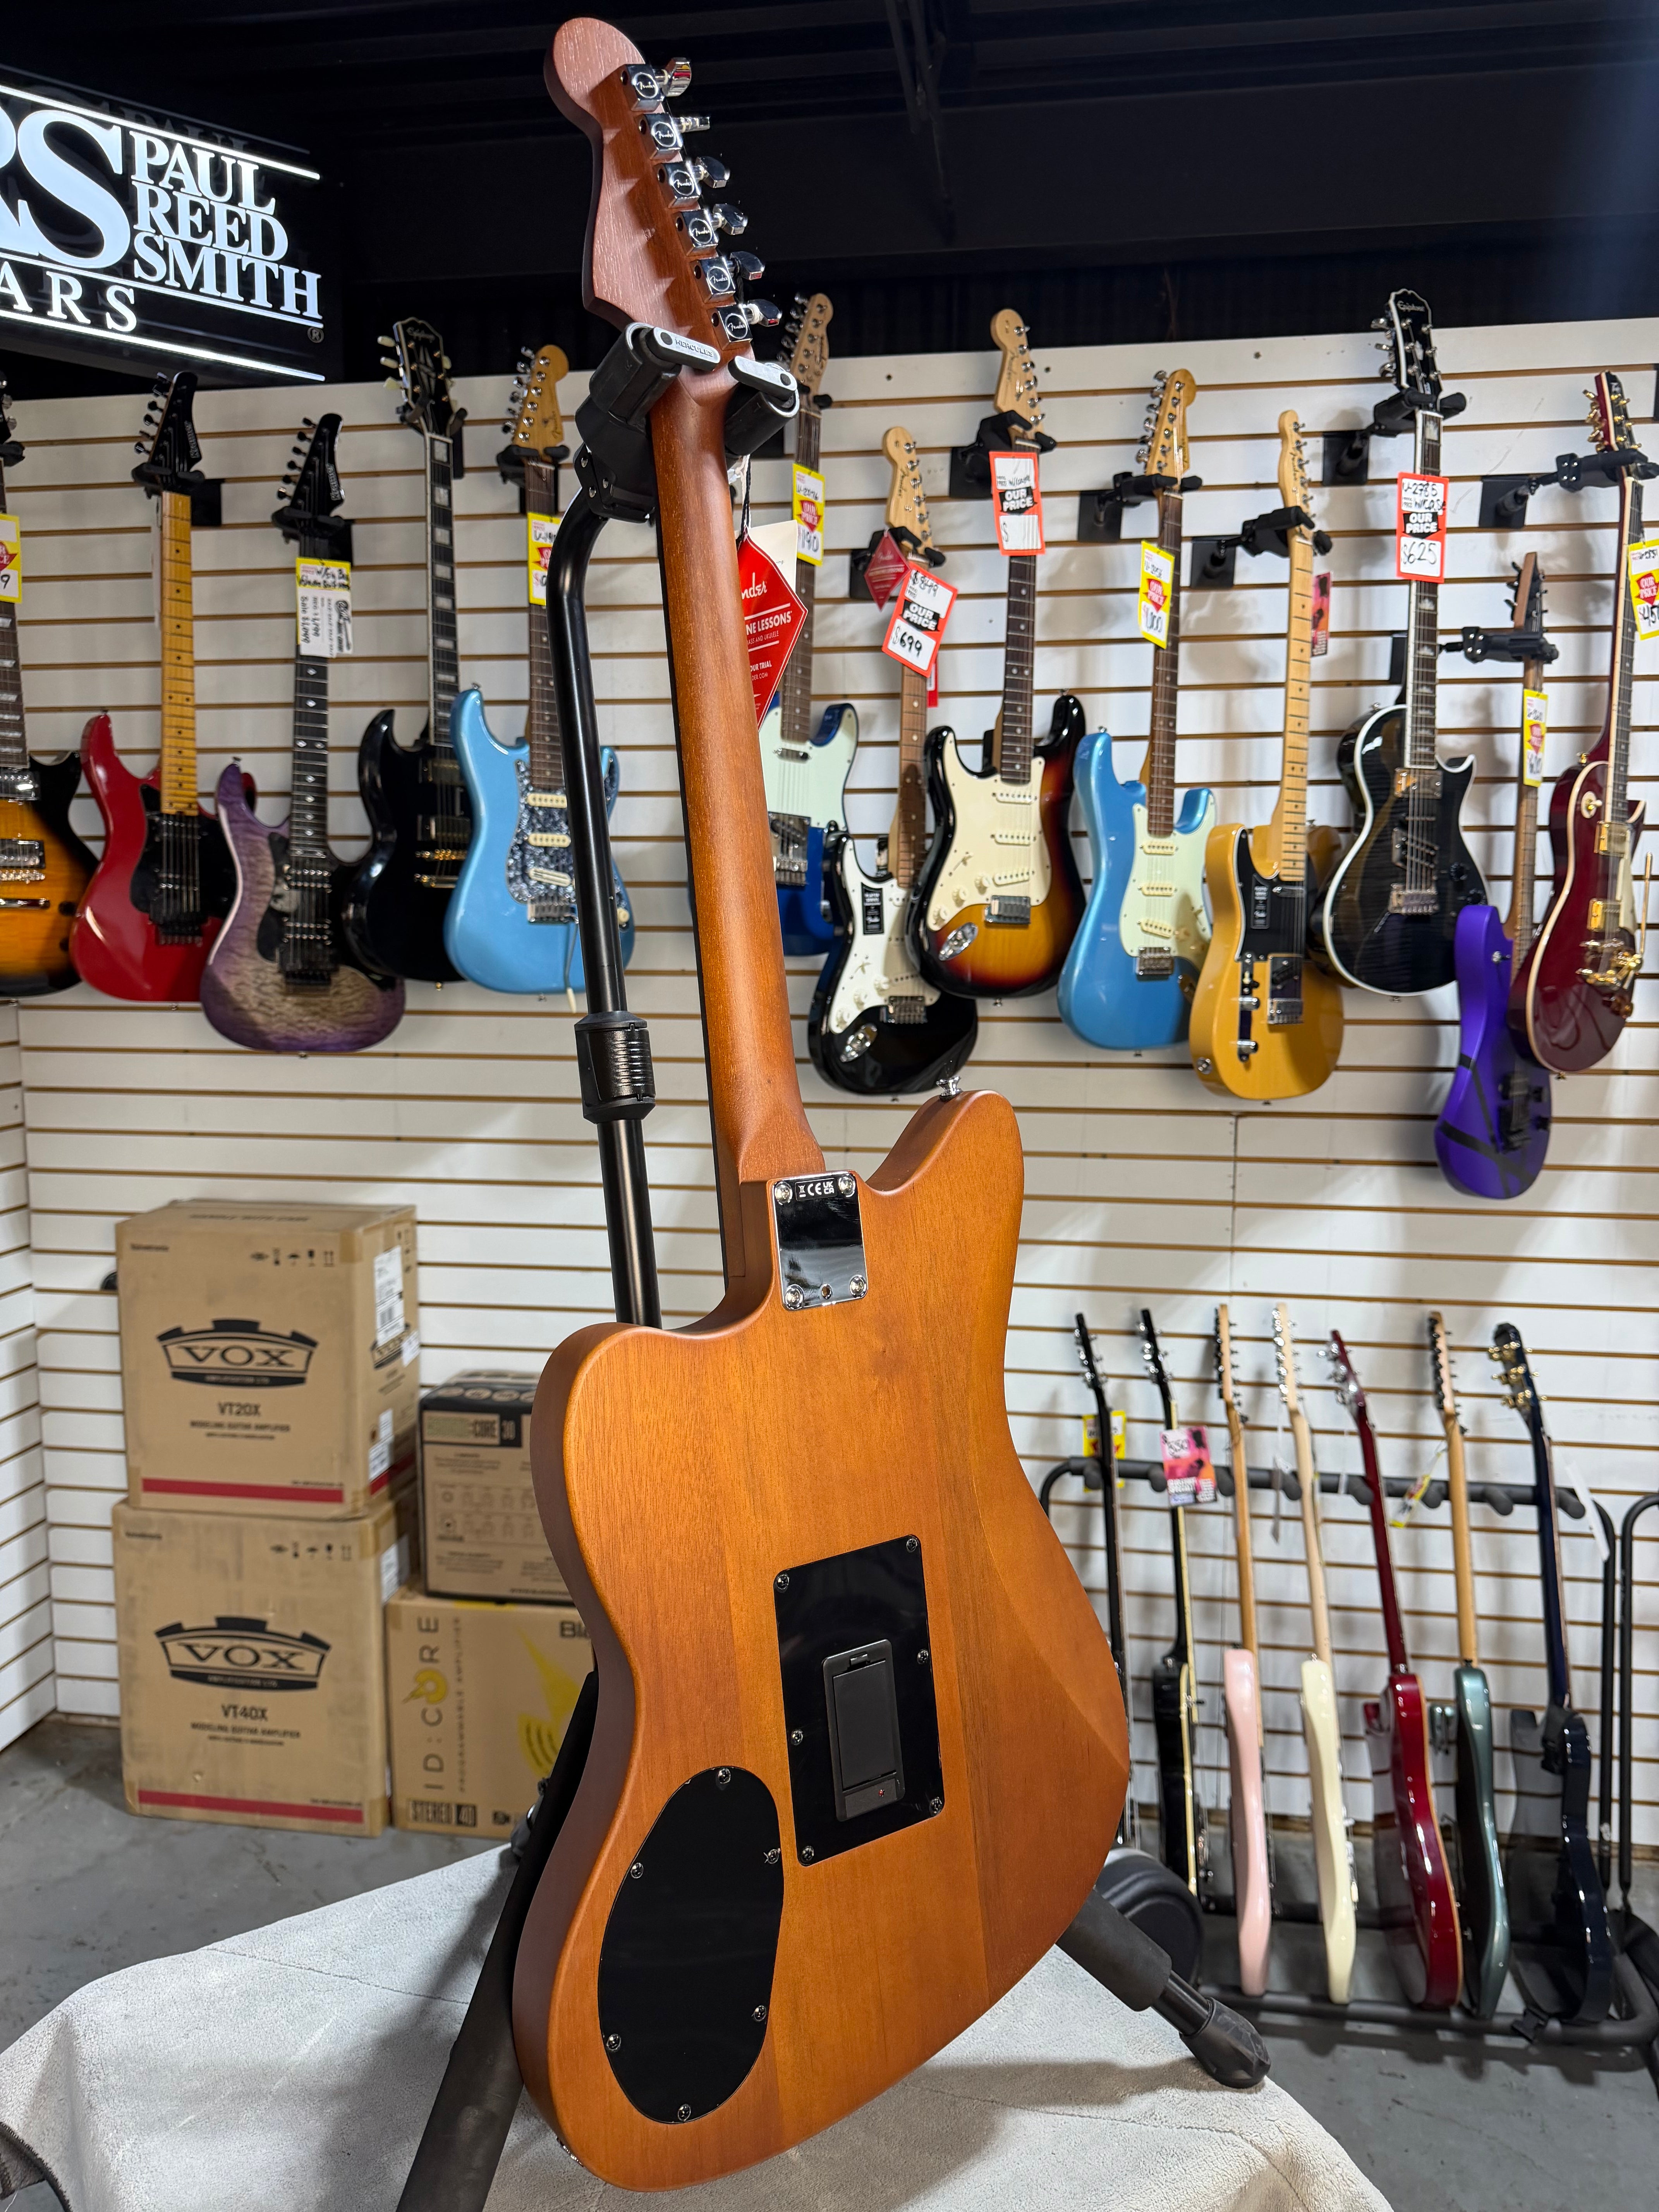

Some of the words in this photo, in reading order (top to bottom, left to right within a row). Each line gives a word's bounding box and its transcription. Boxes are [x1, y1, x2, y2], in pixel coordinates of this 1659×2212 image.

[655, 130, 674, 139] Fender
[129, 130, 275, 215] PAUL
[673, 179, 692, 188] Fender
[132, 180, 288, 262] REED
[692, 227, 710, 236] Fender
[133, 232, 322, 319] SMITH
[710, 275, 728, 283] Fender
[727, 322, 745, 331] Fender
[675, 338, 713, 357] HERCULES
[1005, 489, 1027, 501] OUR
[1003, 498, 1034, 512] PRICE
[1409, 513, 1432, 523] OUR
[1406, 522, 1437, 534] PRICE
[1401, 542, 1437, 564] $625
[742, 572, 767, 600] nder
[1640, 576, 1655, 589] OUR
[1640, 586, 1658, 599] PRICE
[909, 603, 934, 620] OUR
[746, 622, 756, 635] NE
[758, 611, 792, 632] LESSONS
[903, 611, 938, 630] PRICE
[764, 630, 779, 639] UKULELE
[891, 625, 922, 658] $699
[759, 660, 772, 670] TRIAL
[807, 1182, 822, 1196] CE
[178, 1345, 295, 1367] VOX
[218, 1401, 261, 1417] VT20X
[177, 1642, 304, 1671] VOX
[221, 1704, 268, 1721] VT40X
